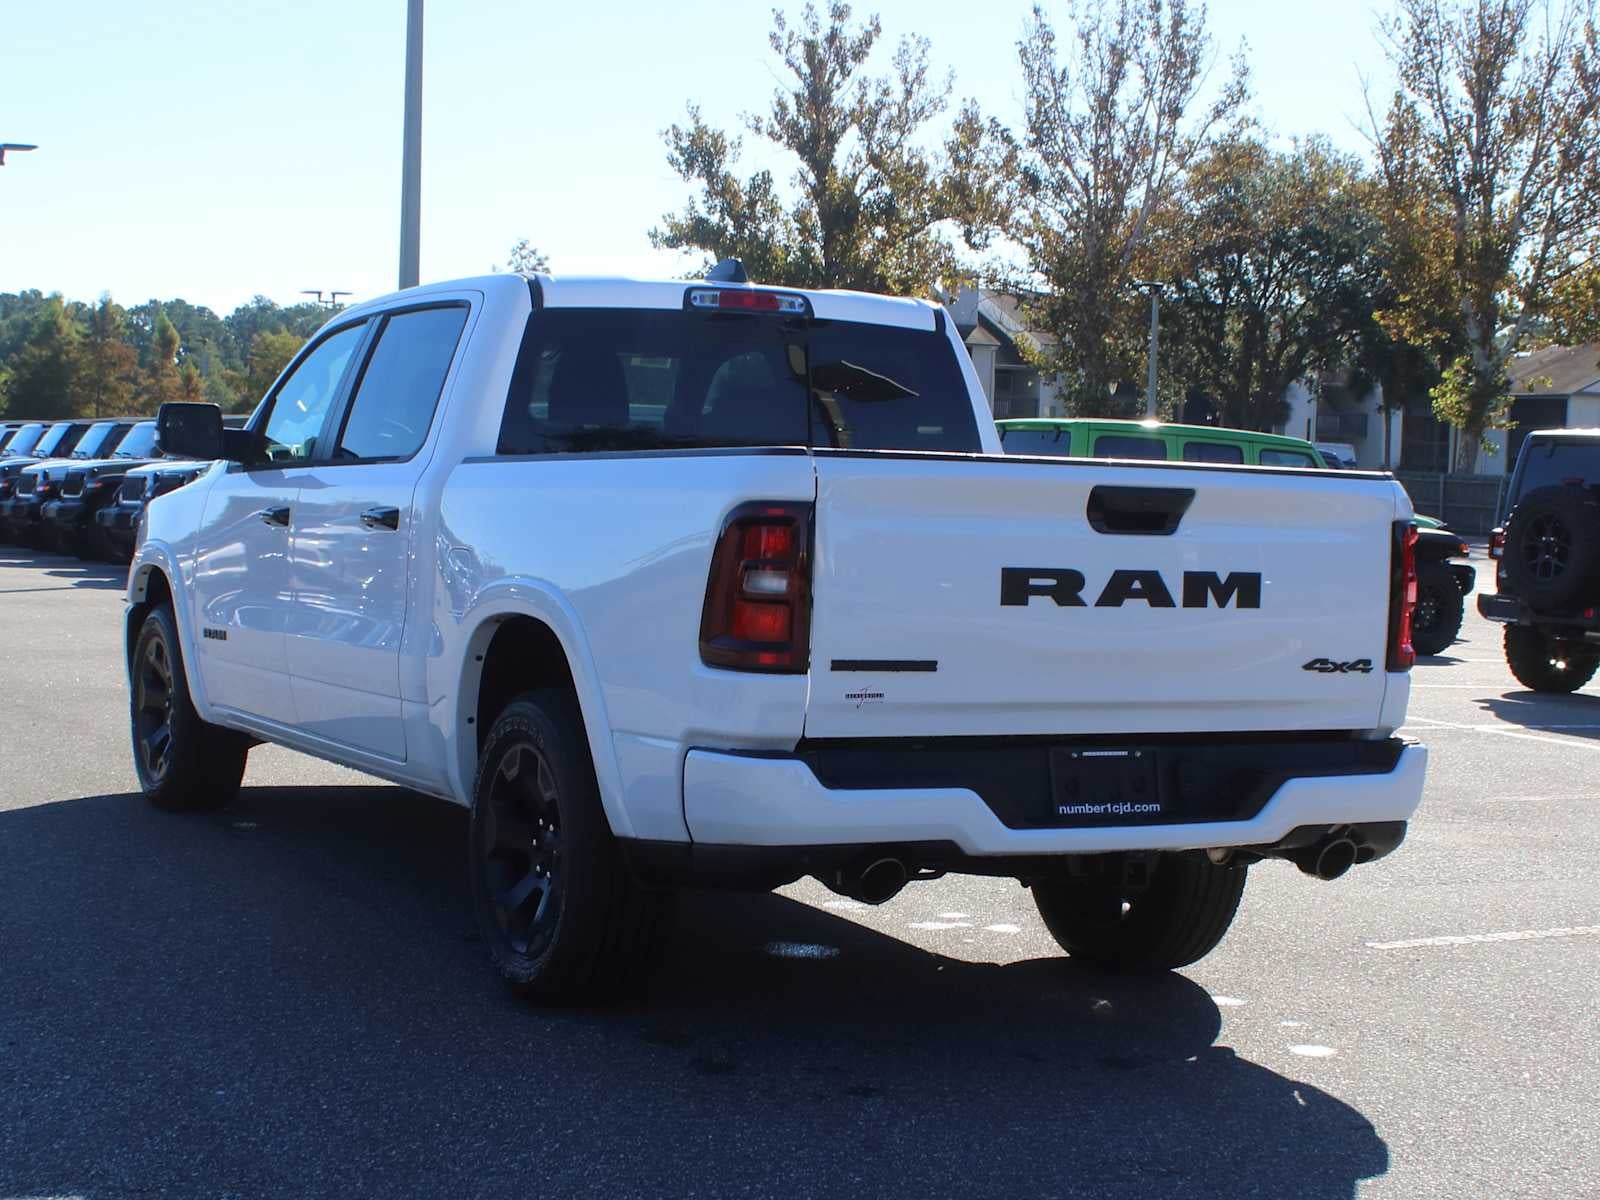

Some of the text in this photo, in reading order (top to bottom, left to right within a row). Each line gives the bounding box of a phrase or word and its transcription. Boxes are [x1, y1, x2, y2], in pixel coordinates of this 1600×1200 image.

[1000, 567, 1262, 609] RAM
[1302, 658, 1374, 674] 4x4
[1058, 802, 1161, 815] number1cjd.com
